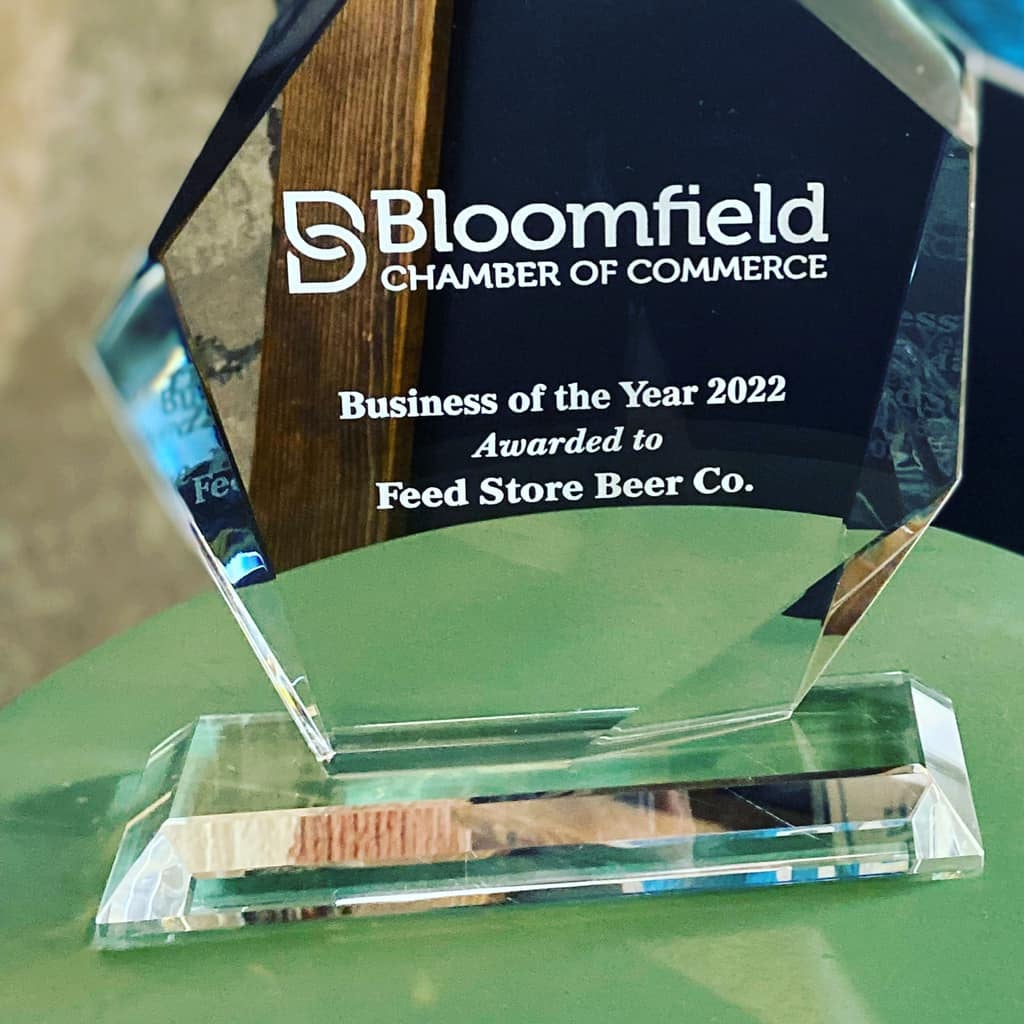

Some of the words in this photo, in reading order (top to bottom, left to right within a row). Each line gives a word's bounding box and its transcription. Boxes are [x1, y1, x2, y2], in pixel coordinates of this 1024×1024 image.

[371, 183, 828, 253] Bloomfield
[381, 262, 561, 291] CHAMBER
[570, 260, 617, 285] OF
[627, 255, 827, 284] COMMERCE
[338, 389, 497, 419] Business
[509, 384, 547, 412] of
[554, 383, 610, 411] the
[619, 381, 698, 407] Year
[707, 375, 785, 404] 2022
[472, 427, 624, 457] Awarded
[633, 430, 662, 450] to
[376, 478, 469, 509] Feed
[480, 478, 583, 504] Store
[595, 473, 683, 498] Beer
[694, 468, 753, 494] Co.
